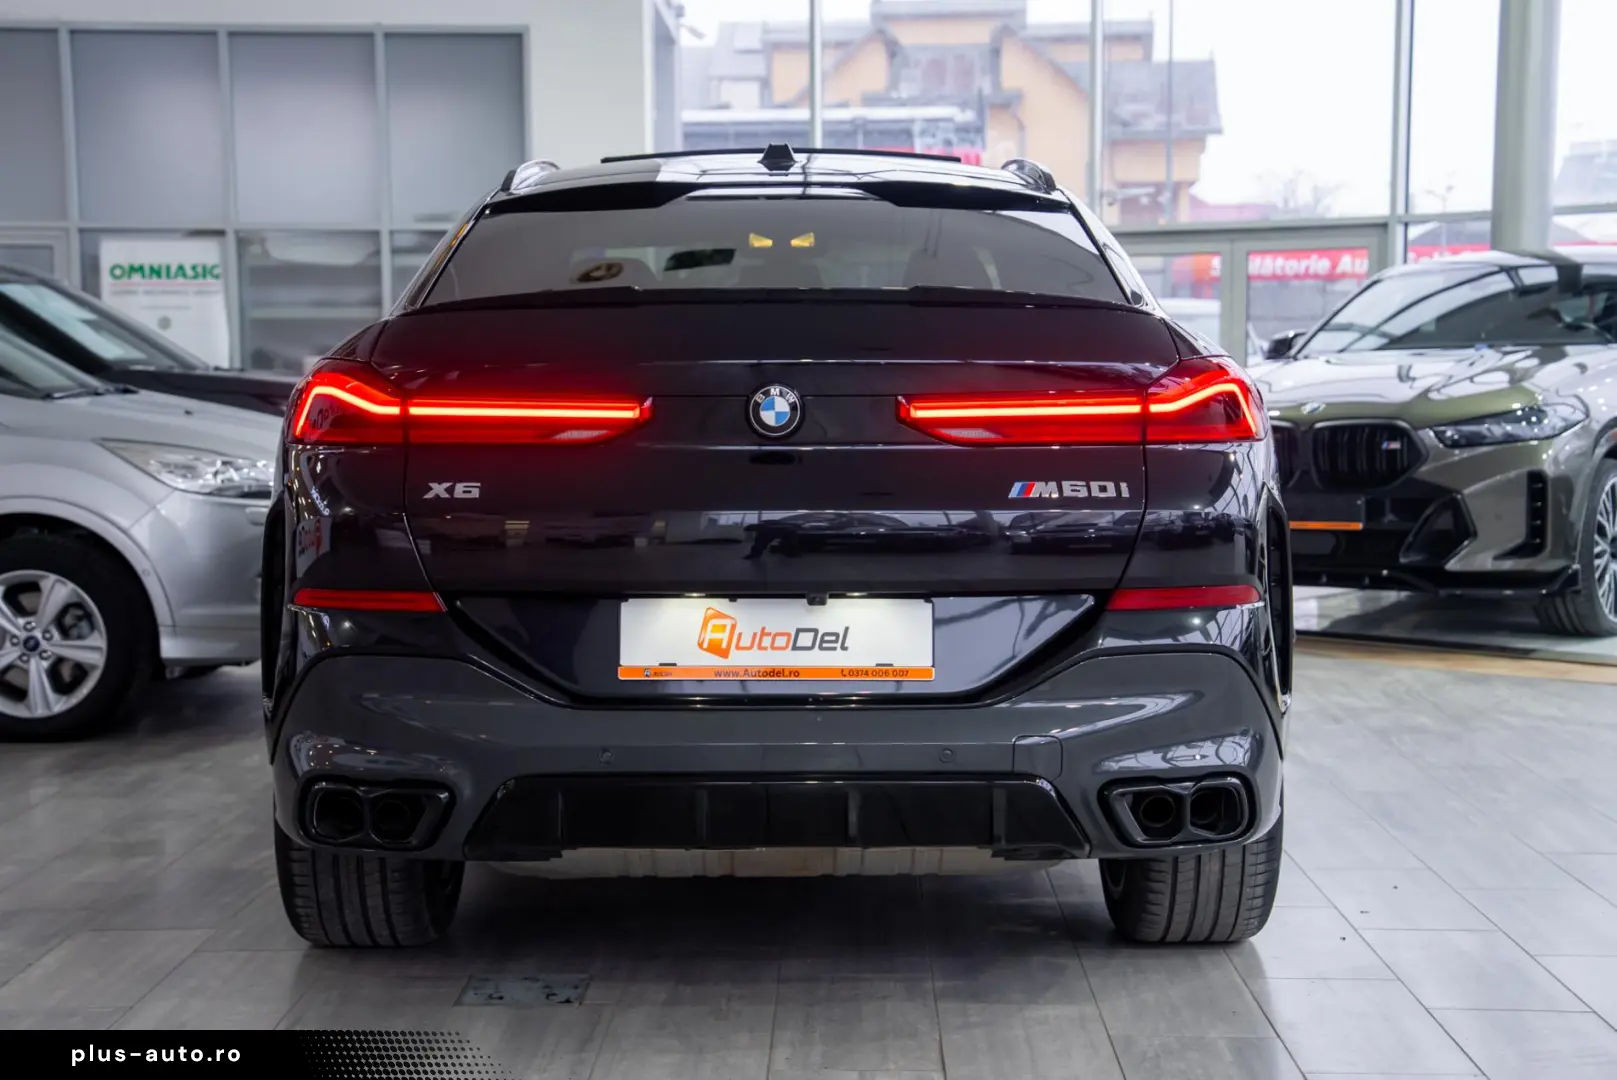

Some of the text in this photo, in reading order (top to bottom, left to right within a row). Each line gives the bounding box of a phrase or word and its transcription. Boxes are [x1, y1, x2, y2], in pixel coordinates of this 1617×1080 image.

[755, 387, 796, 404] BMW
[422, 482, 481, 499] X6
[699, 614, 850, 654] AutoDel
[713, 667, 800, 679] www.Autodel.ro
[847, 667, 869, 678] 0374
[871, 667, 890, 678] 006
